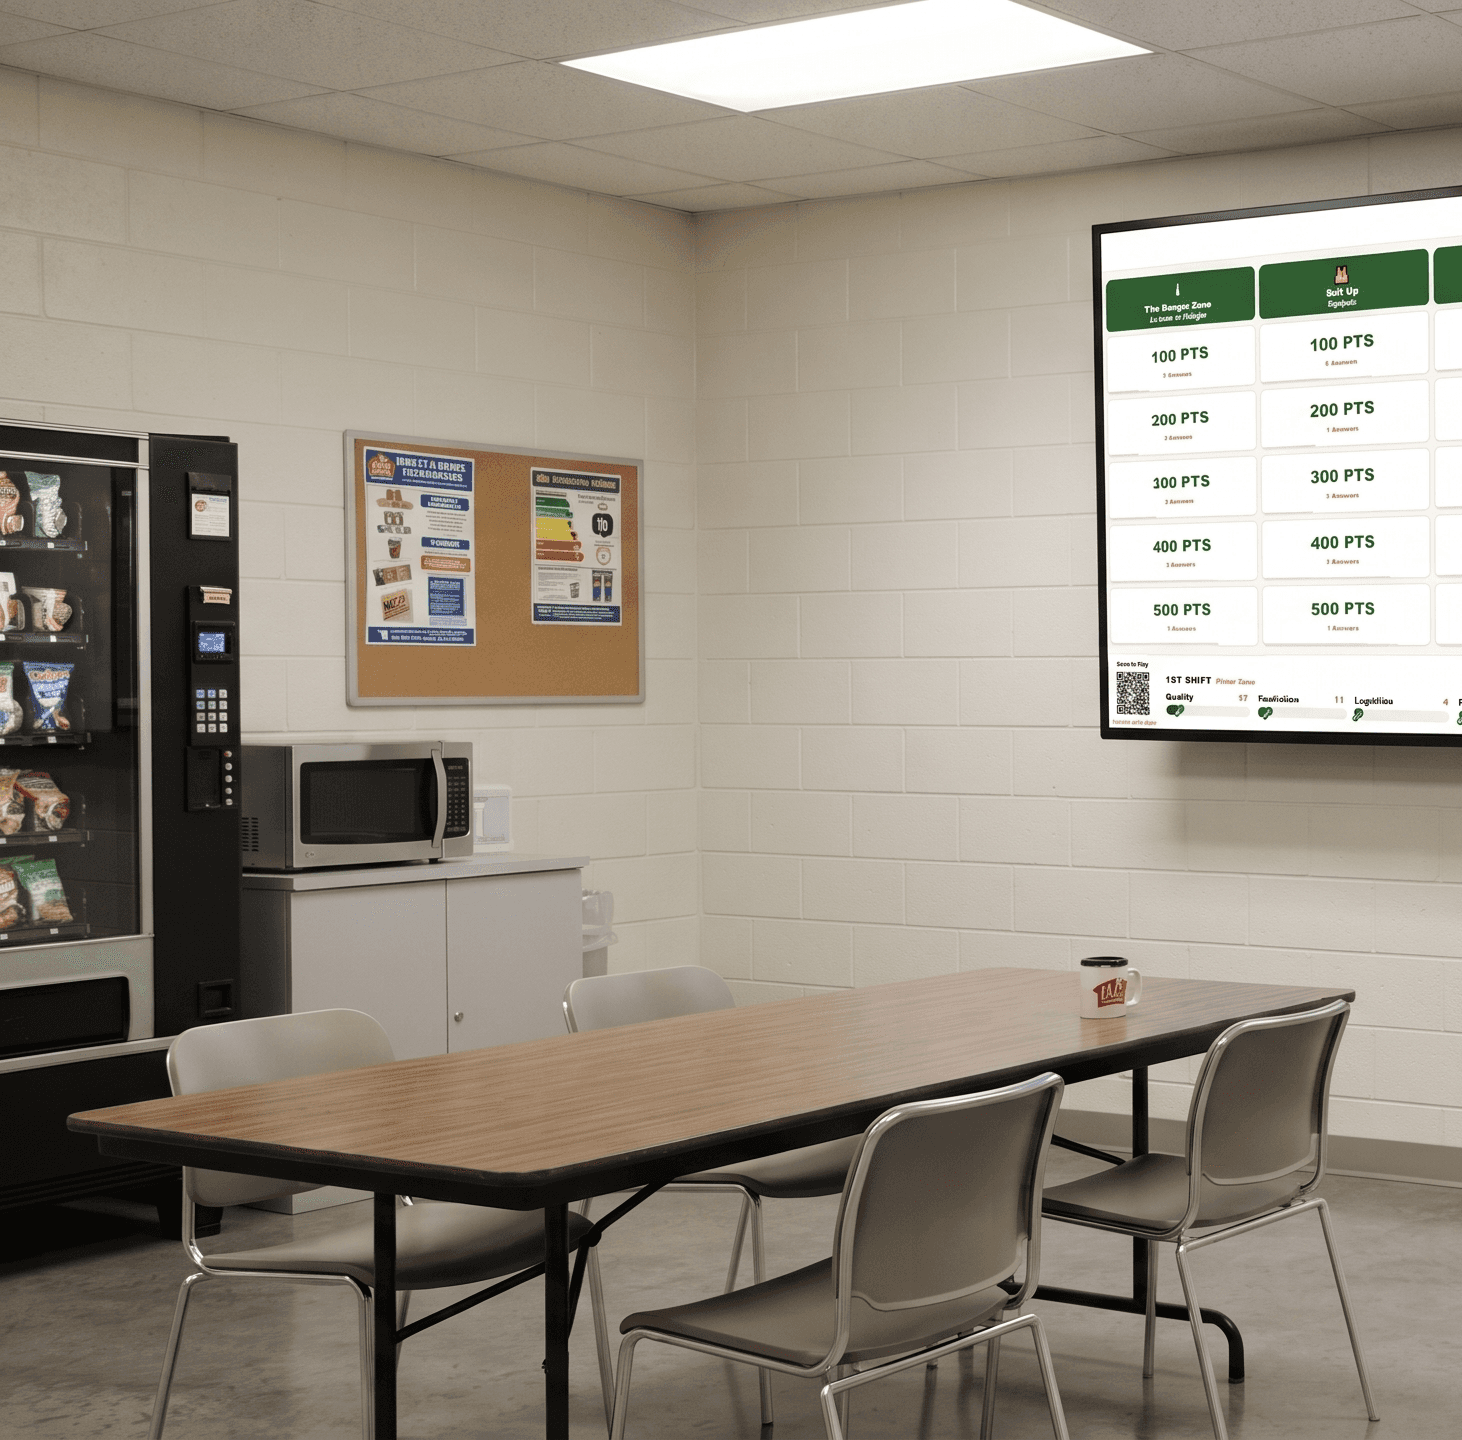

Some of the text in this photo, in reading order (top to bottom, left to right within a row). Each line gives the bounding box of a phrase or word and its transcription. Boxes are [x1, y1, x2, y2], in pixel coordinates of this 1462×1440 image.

[1346, 287, 1359, 296] Up
[1144, 305, 1160, 313] The
[1310, 334, 1374, 351] 100 PTS
[1152, 346, 1208, 363] 100 PTS
[1310, 401, 1374, 417] 200 PTS
[1152, 411, 1209, 426] 200 PTS
[1182, 475, 1210, 488] PTS
[1311, 468, 1374, 484] 300 PTS
[1153, 538, 1211, 553] 400 PTS
[1311, 535, 1375, 549] 400 PTS
[1154, 603, 1211, 616] 500 PTS
[1311, 602, 1375, 616] 500 PTS
[1185, 676, 1212, 684] SHIFT
[1166, 693, 1193, 702] Quality
